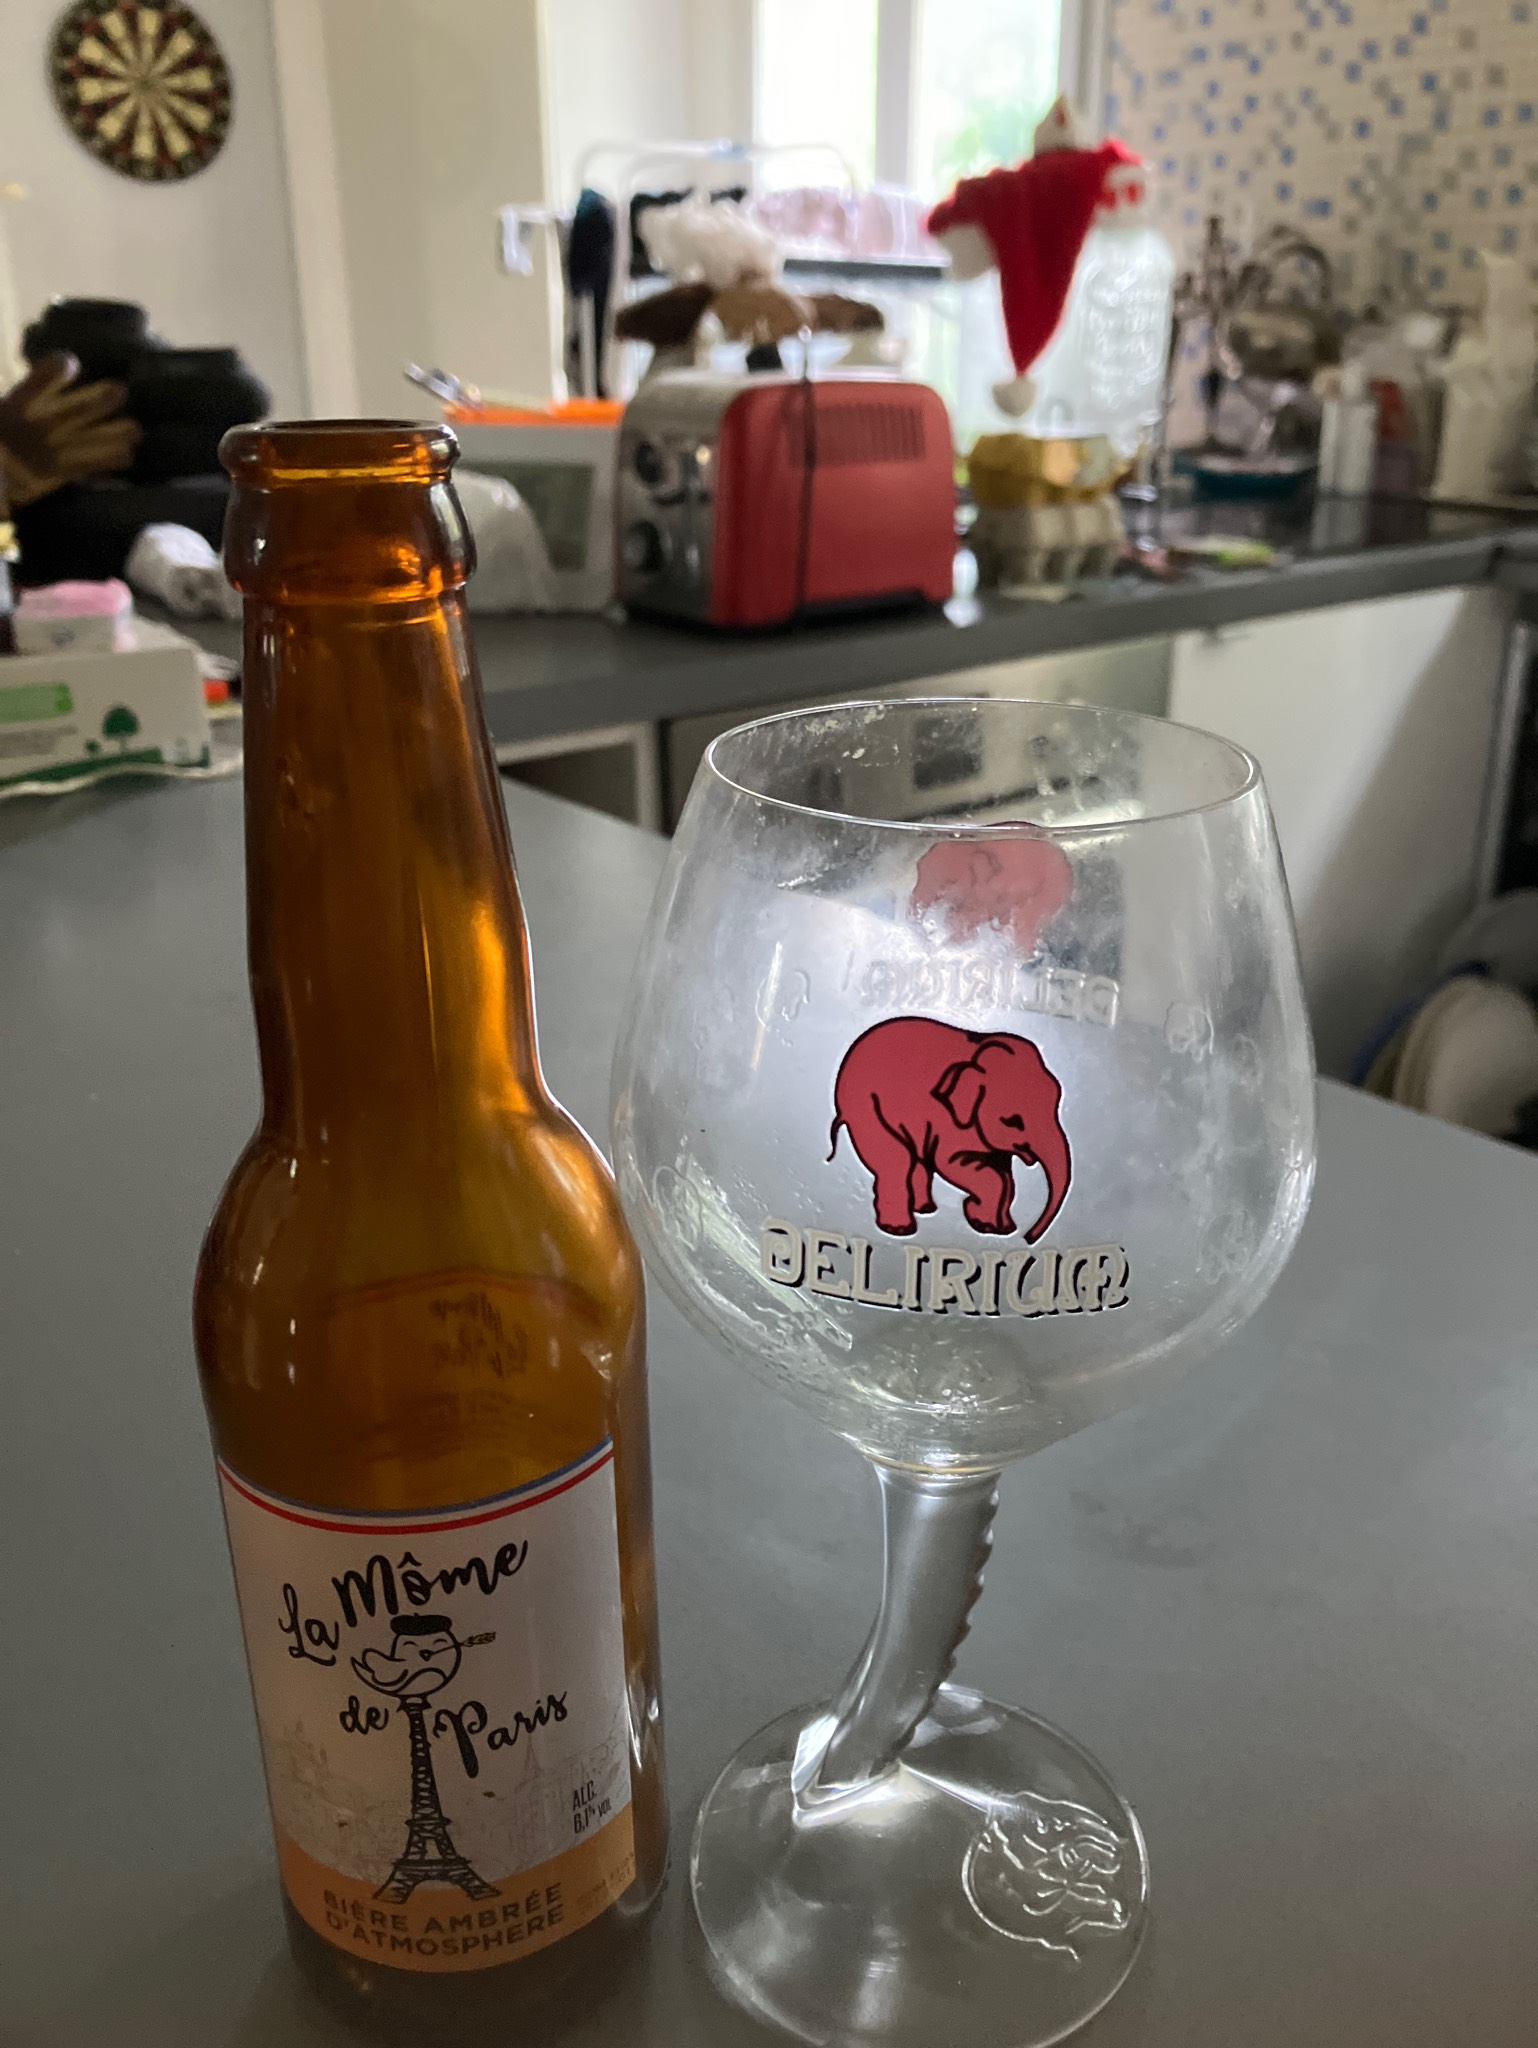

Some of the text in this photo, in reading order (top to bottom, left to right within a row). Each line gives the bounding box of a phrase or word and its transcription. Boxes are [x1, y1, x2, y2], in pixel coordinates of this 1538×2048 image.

[760, 1216, 1130, 1319] DELIRIUM
[278, 1539, 529, 1667] La Môme
[339, 1691, 569, 1779] de Paris
[572, 1780, 597, 1811] ALC.
[323, 1882, 563, 1935] BIÈRE AMBRÉE
[325, 1903, 565, 1956] D'ATMOSPHERE
